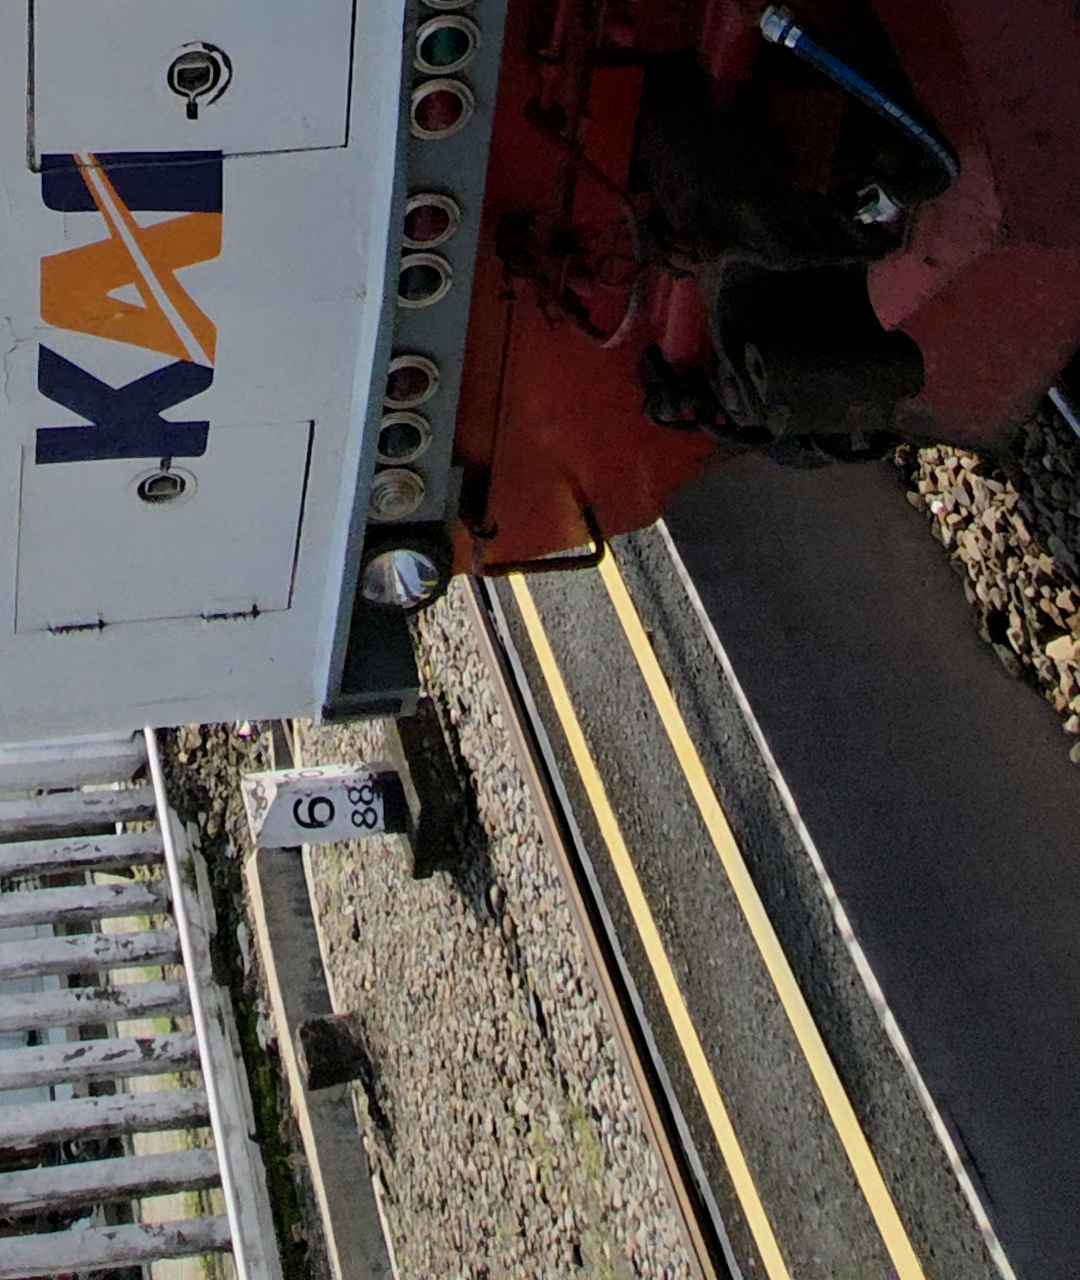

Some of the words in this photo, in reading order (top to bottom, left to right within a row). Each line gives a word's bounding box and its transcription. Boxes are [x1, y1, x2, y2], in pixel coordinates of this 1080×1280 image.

[35, 150, 223, 464] KAI
[294, 797, 335, 829] 6
[348, 784, 378, 829] 88
